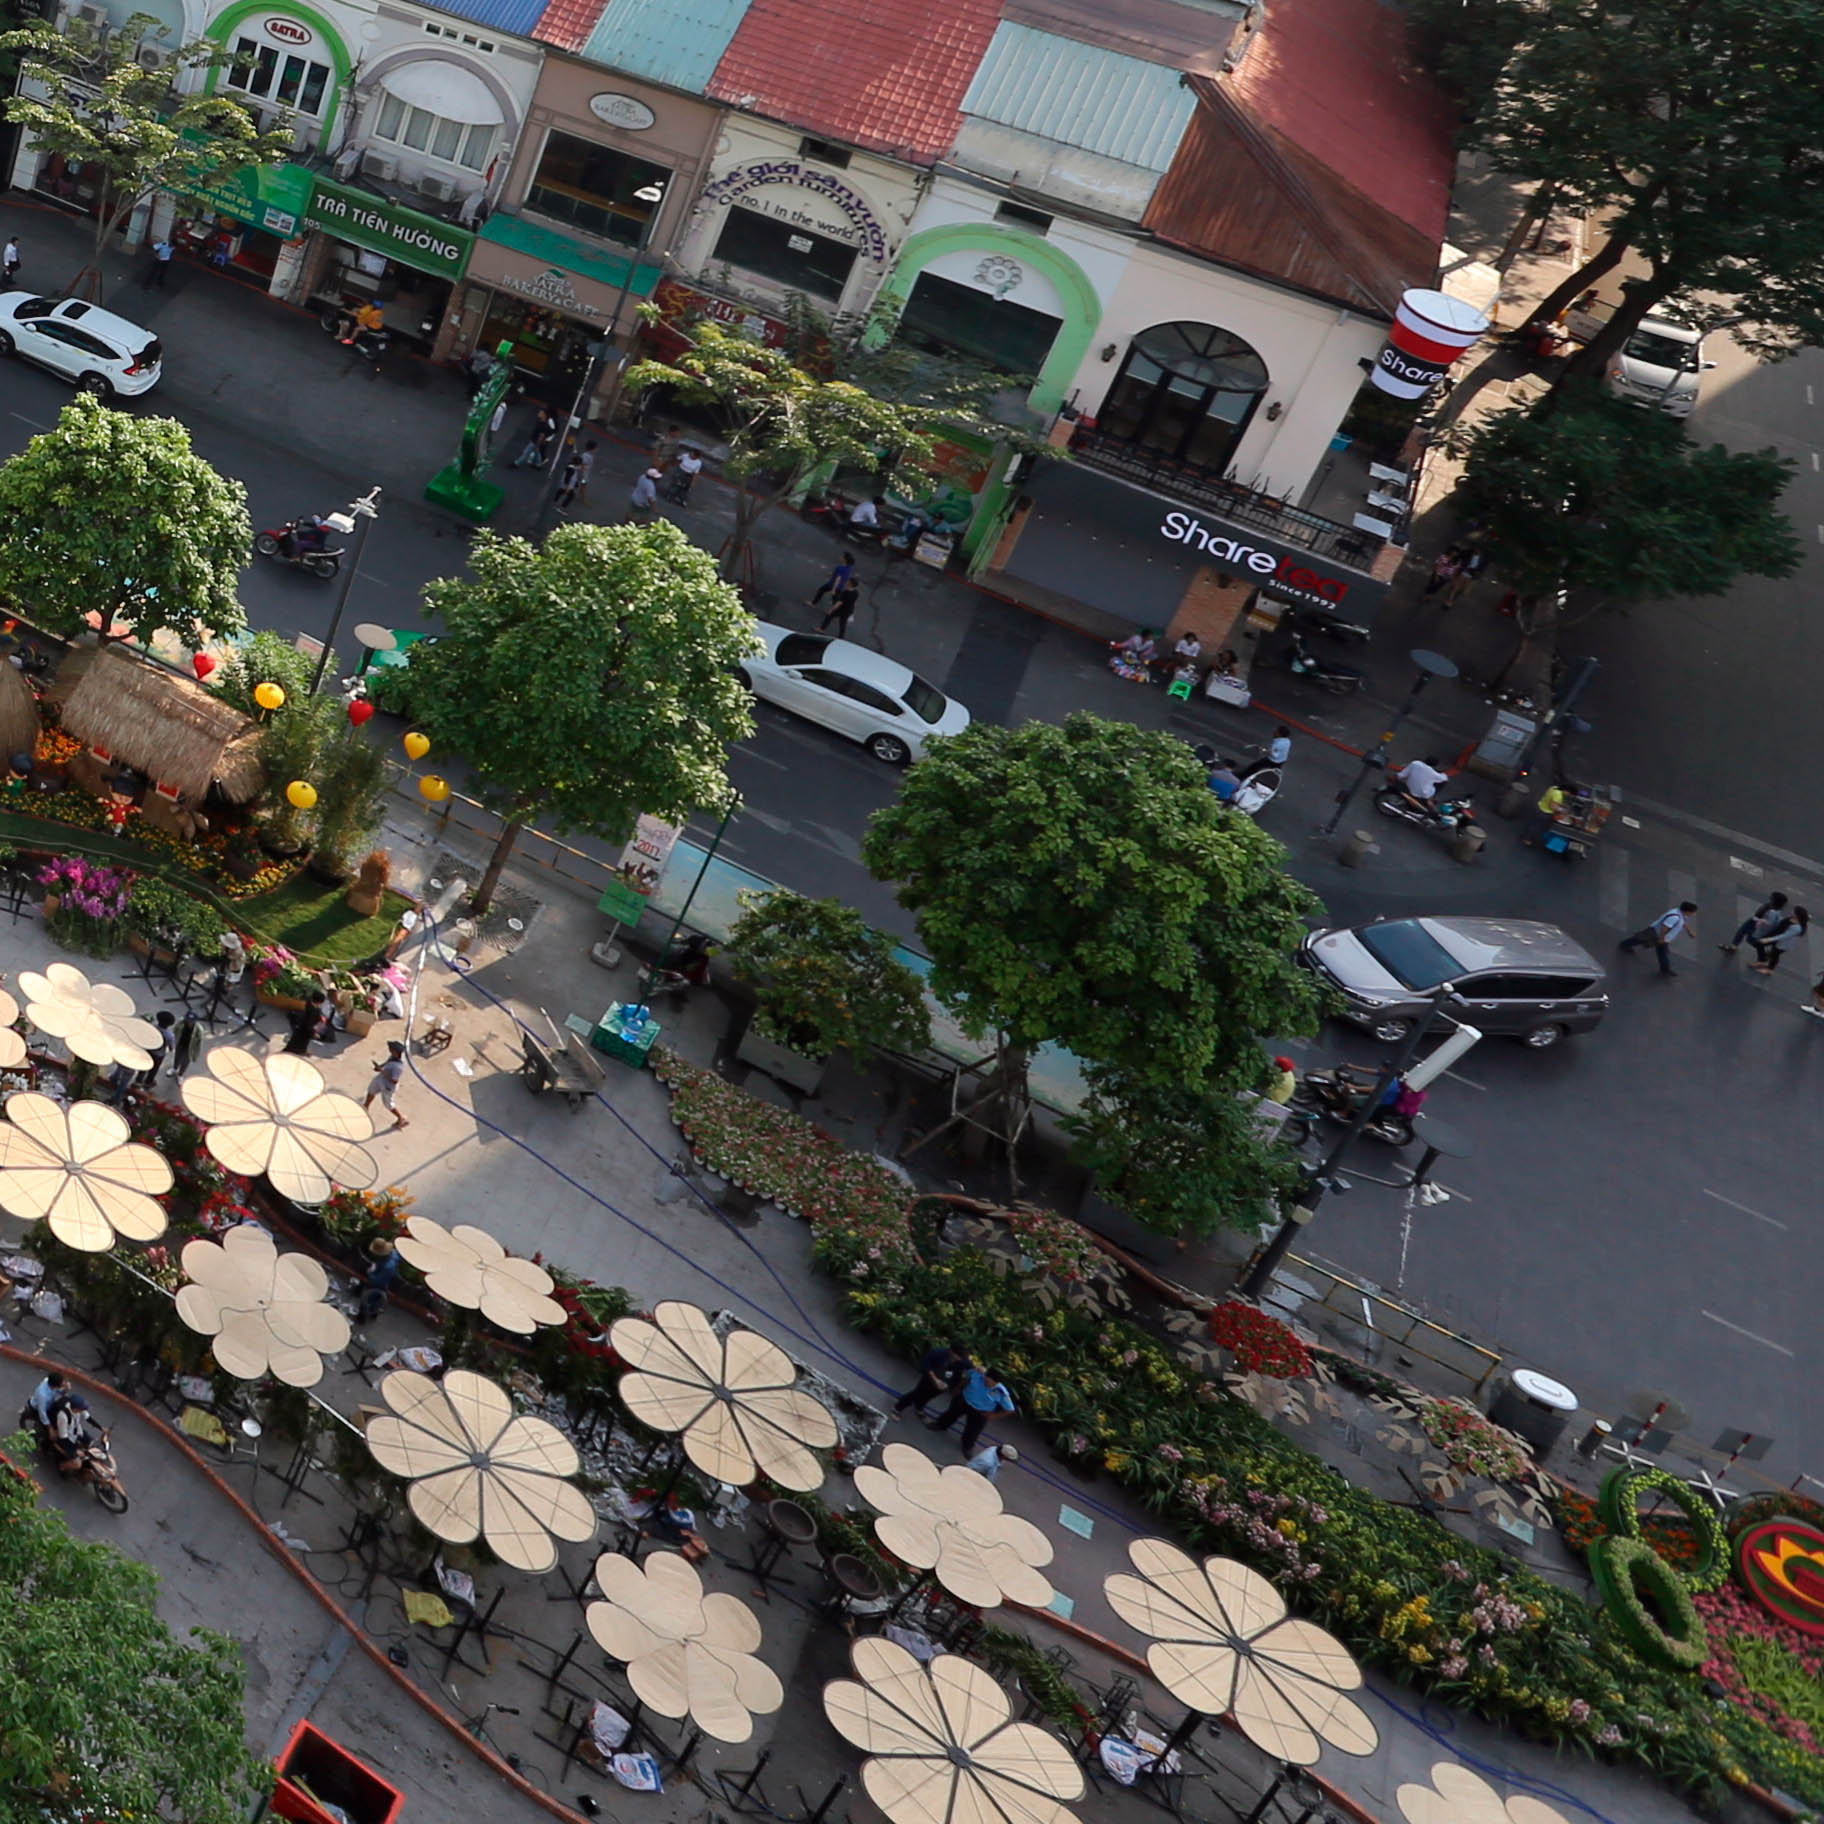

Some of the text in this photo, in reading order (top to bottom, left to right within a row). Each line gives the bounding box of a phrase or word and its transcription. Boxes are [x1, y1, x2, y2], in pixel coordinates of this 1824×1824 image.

[269, 21, 306, 42] SATRA
[718, 175, 793, 206] Garden
[747, 160, 801, 177] giới
[805, 170, 854, 202] sân
[316, 194, 460, 261] TRÀ TIÊN HƯỞNG
[774, 204, 788, 218] in
[791, 209, 813, 227] the
[816, 219, 853, 241] world
[1381, 348, 1444, 383] Share
[1159, 511, 1350, 603] Sharetea
[1267, 578, 1337, 610] Since 1992
[635, 839, 661, 857] 2017
